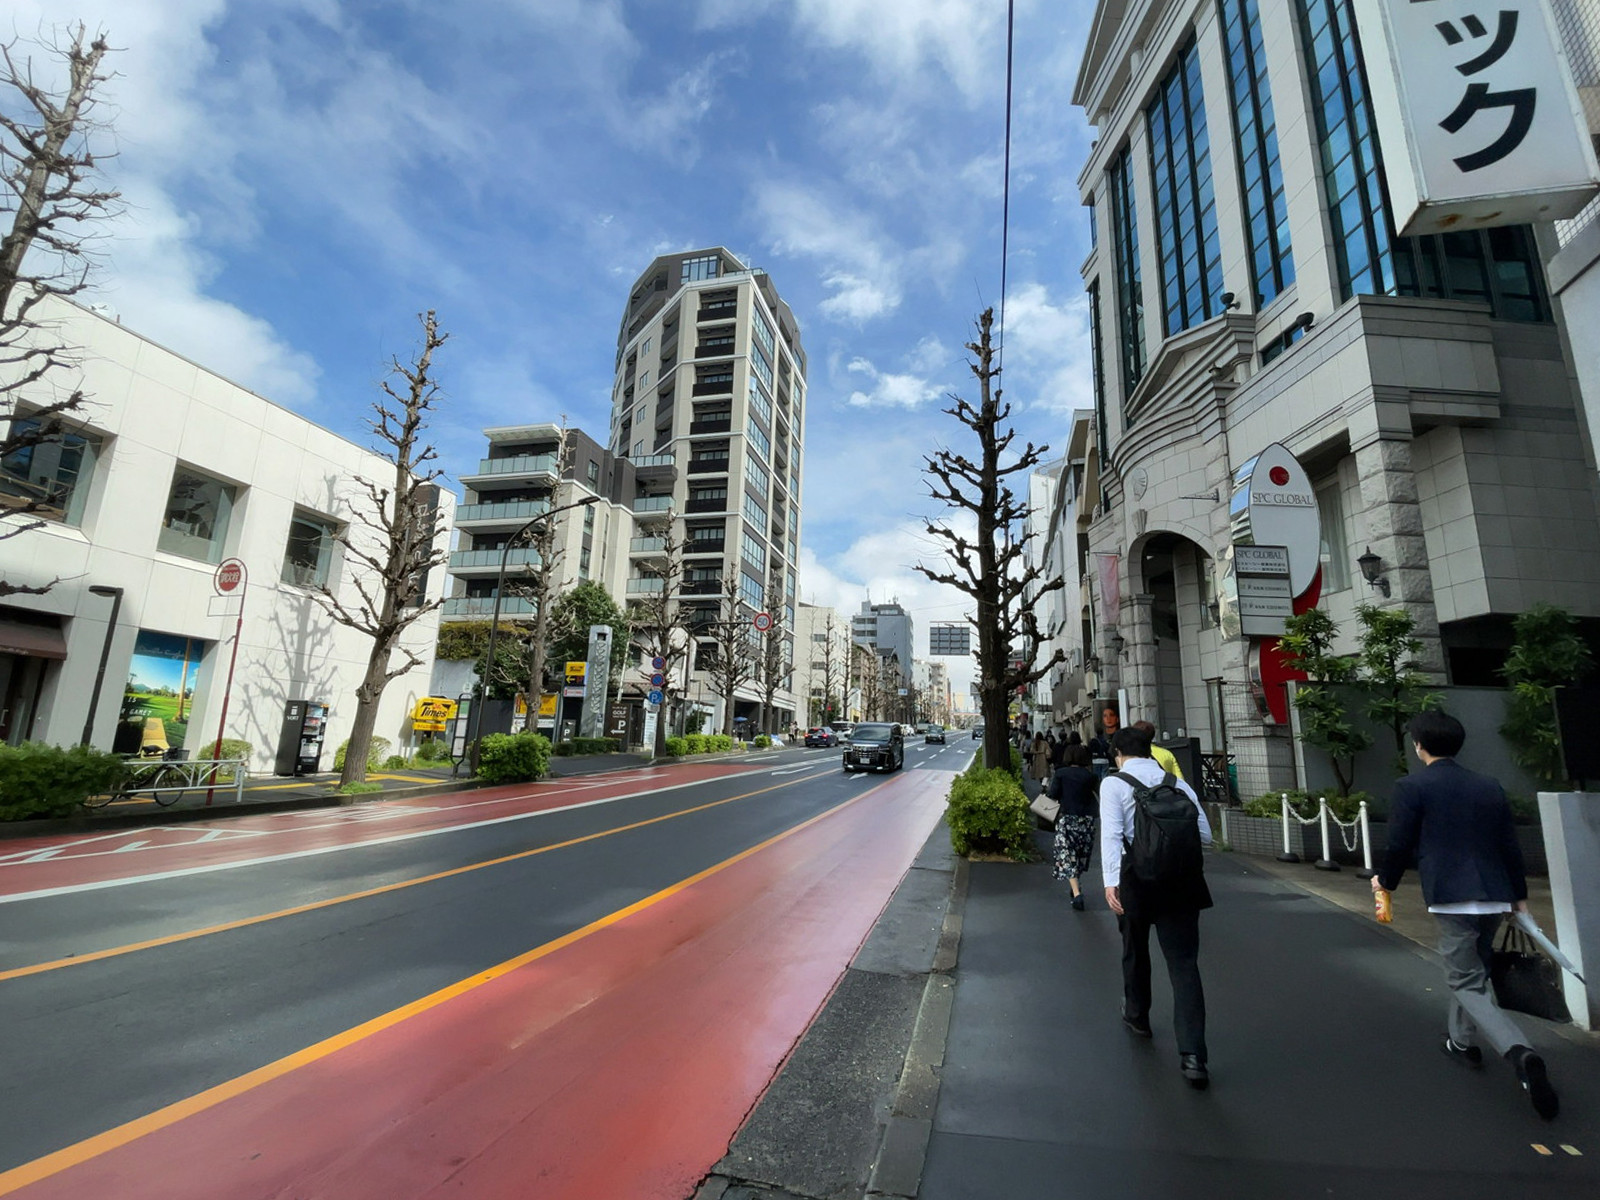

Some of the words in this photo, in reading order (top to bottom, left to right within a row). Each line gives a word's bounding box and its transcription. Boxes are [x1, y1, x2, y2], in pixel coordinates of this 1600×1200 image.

[1409, 0, 1537, 173] ック
[1252, 492, 1271, 503] SPC
[1273, 493, 1313, 505] GLOBAL
[1237, 550, 1251, 558] SPC
[1252, 550, 1284, 559] GLOBAL
[757, 617, 768, 627] 50
[421, 706, 447, 717] Times
[618, 720, 626, 729] P
